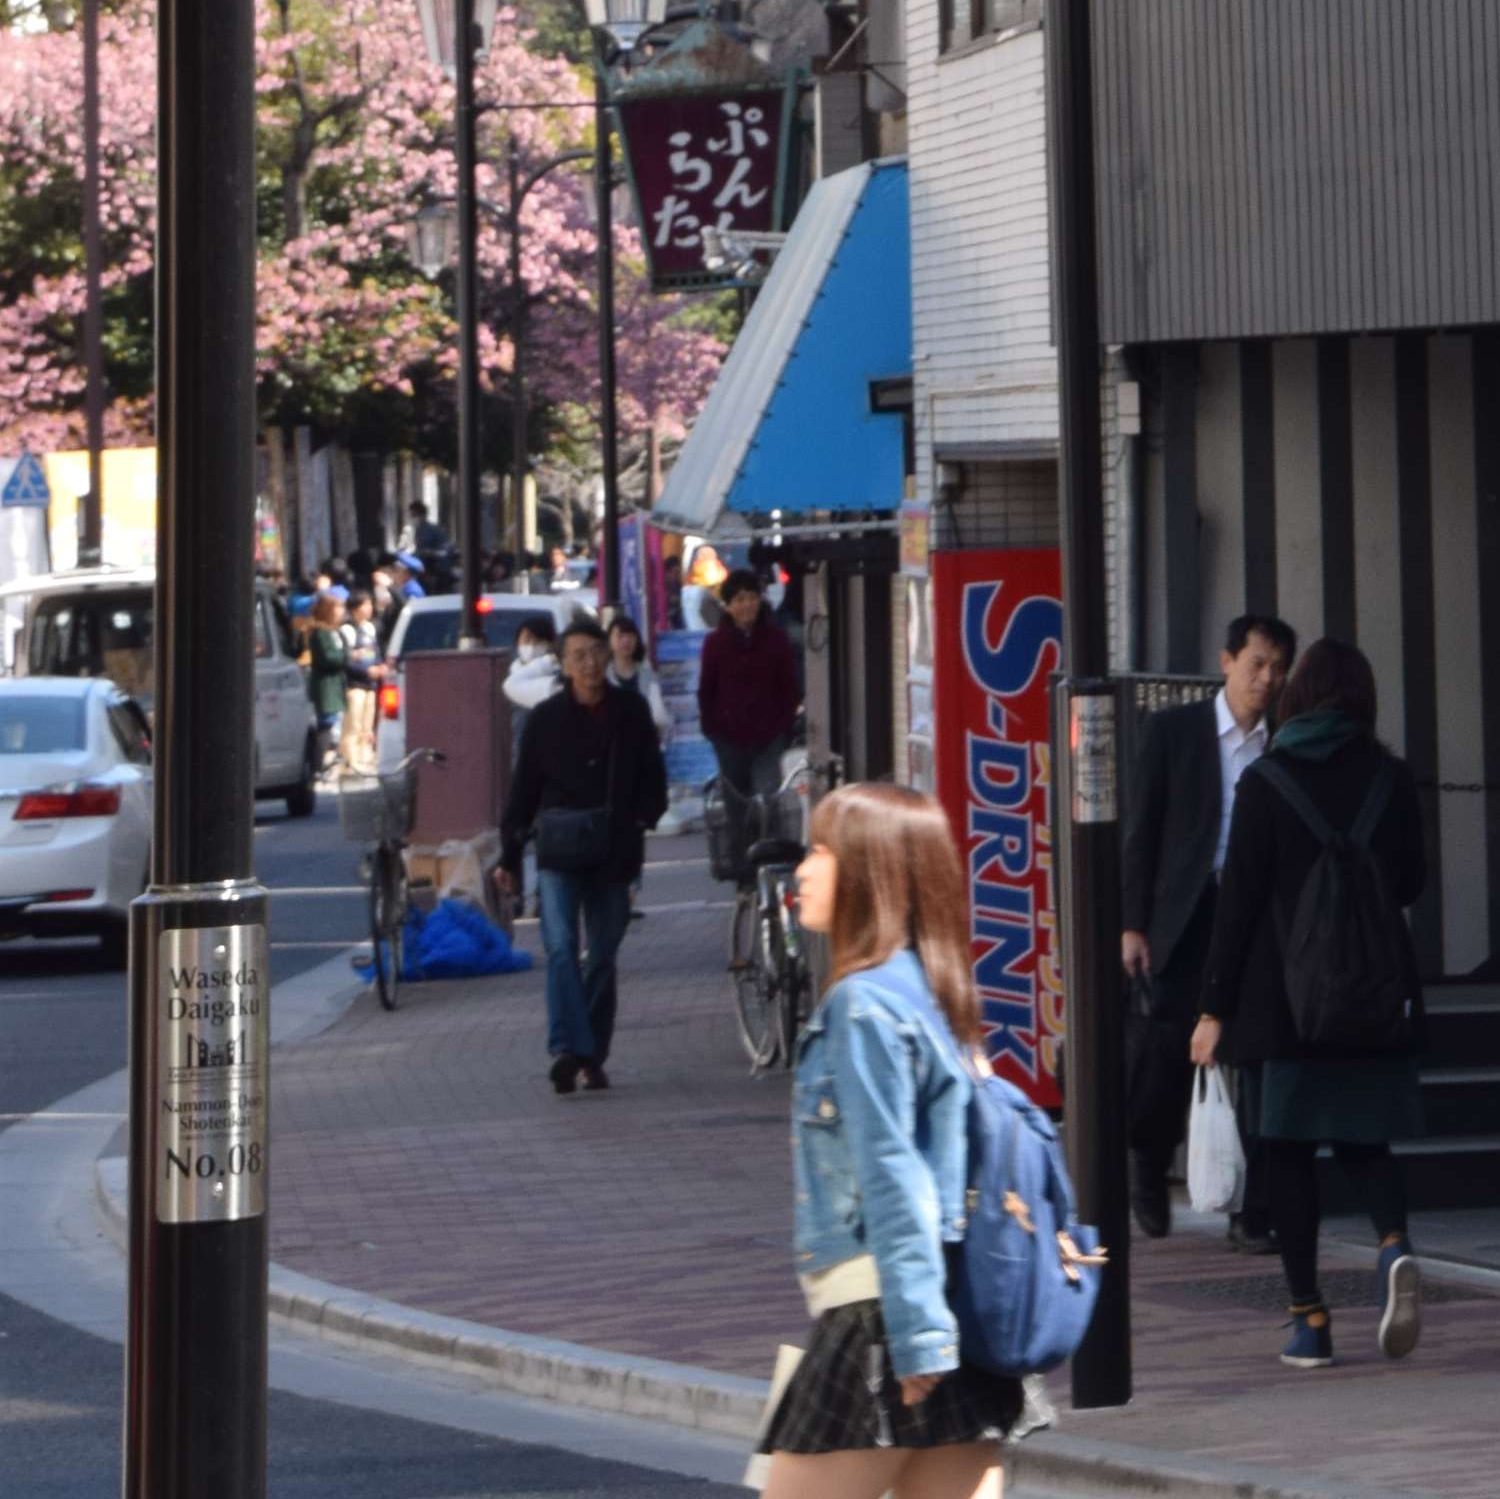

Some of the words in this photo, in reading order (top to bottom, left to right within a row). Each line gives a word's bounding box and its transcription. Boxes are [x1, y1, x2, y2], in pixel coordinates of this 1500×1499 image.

[170, 961, 258, 989] Waseda
[168, 992, 260, 1026] Daigaku
[166, 1142, 260, 1180] No.08
